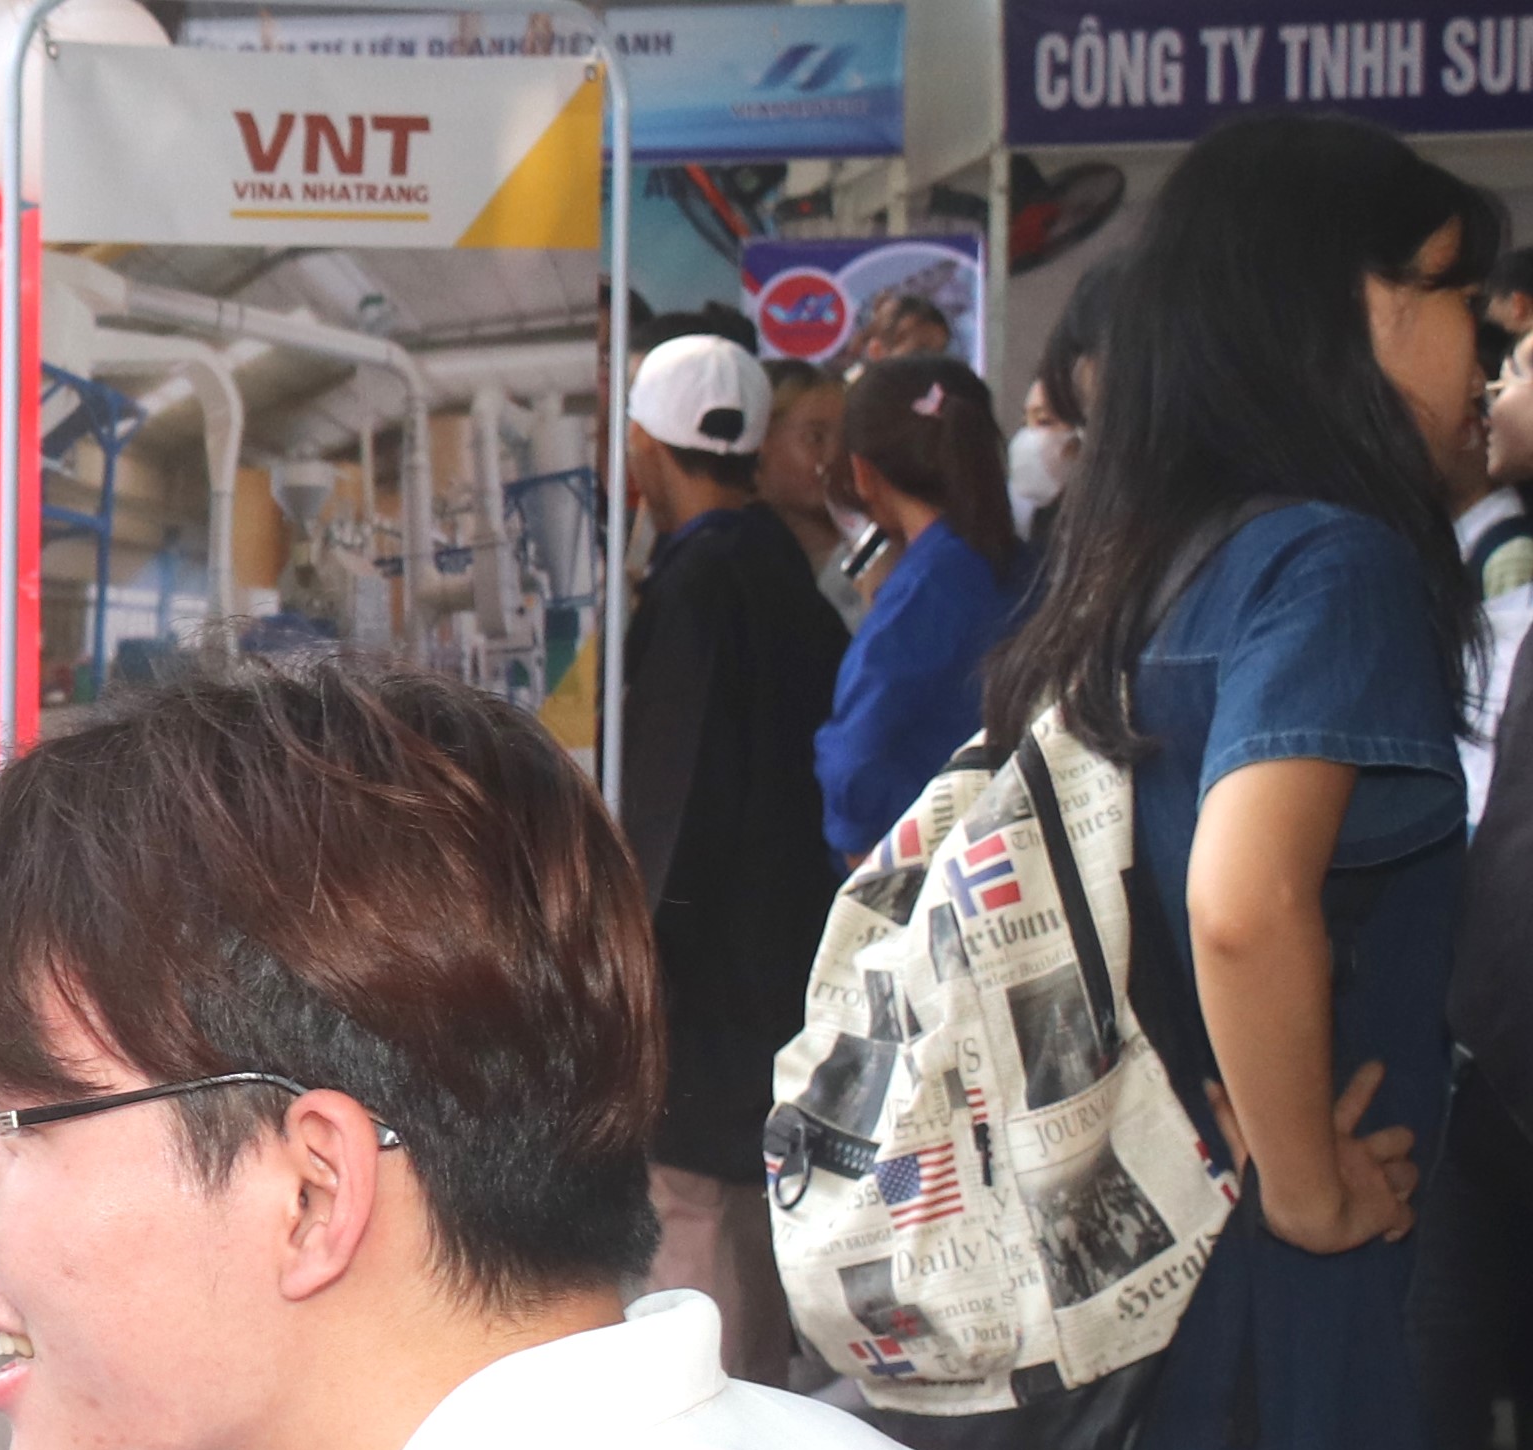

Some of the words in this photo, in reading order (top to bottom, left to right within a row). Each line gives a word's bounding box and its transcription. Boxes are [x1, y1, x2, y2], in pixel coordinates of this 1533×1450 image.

[614, 30, 672, 55] ANH
[1034, 14, 1184, 110] CÔNG
[1198, 26, 1264, 103] TY
[1278, 20, 1426, 101] TNHH
[232, 110, 431, 177] VNT
[232, 181, 294, 201] VINA
[301, 183, 430, 205] NHATRANG
[965, 907, 1062, 956] ribun
[896, 1237, 982, 1283] Daily
